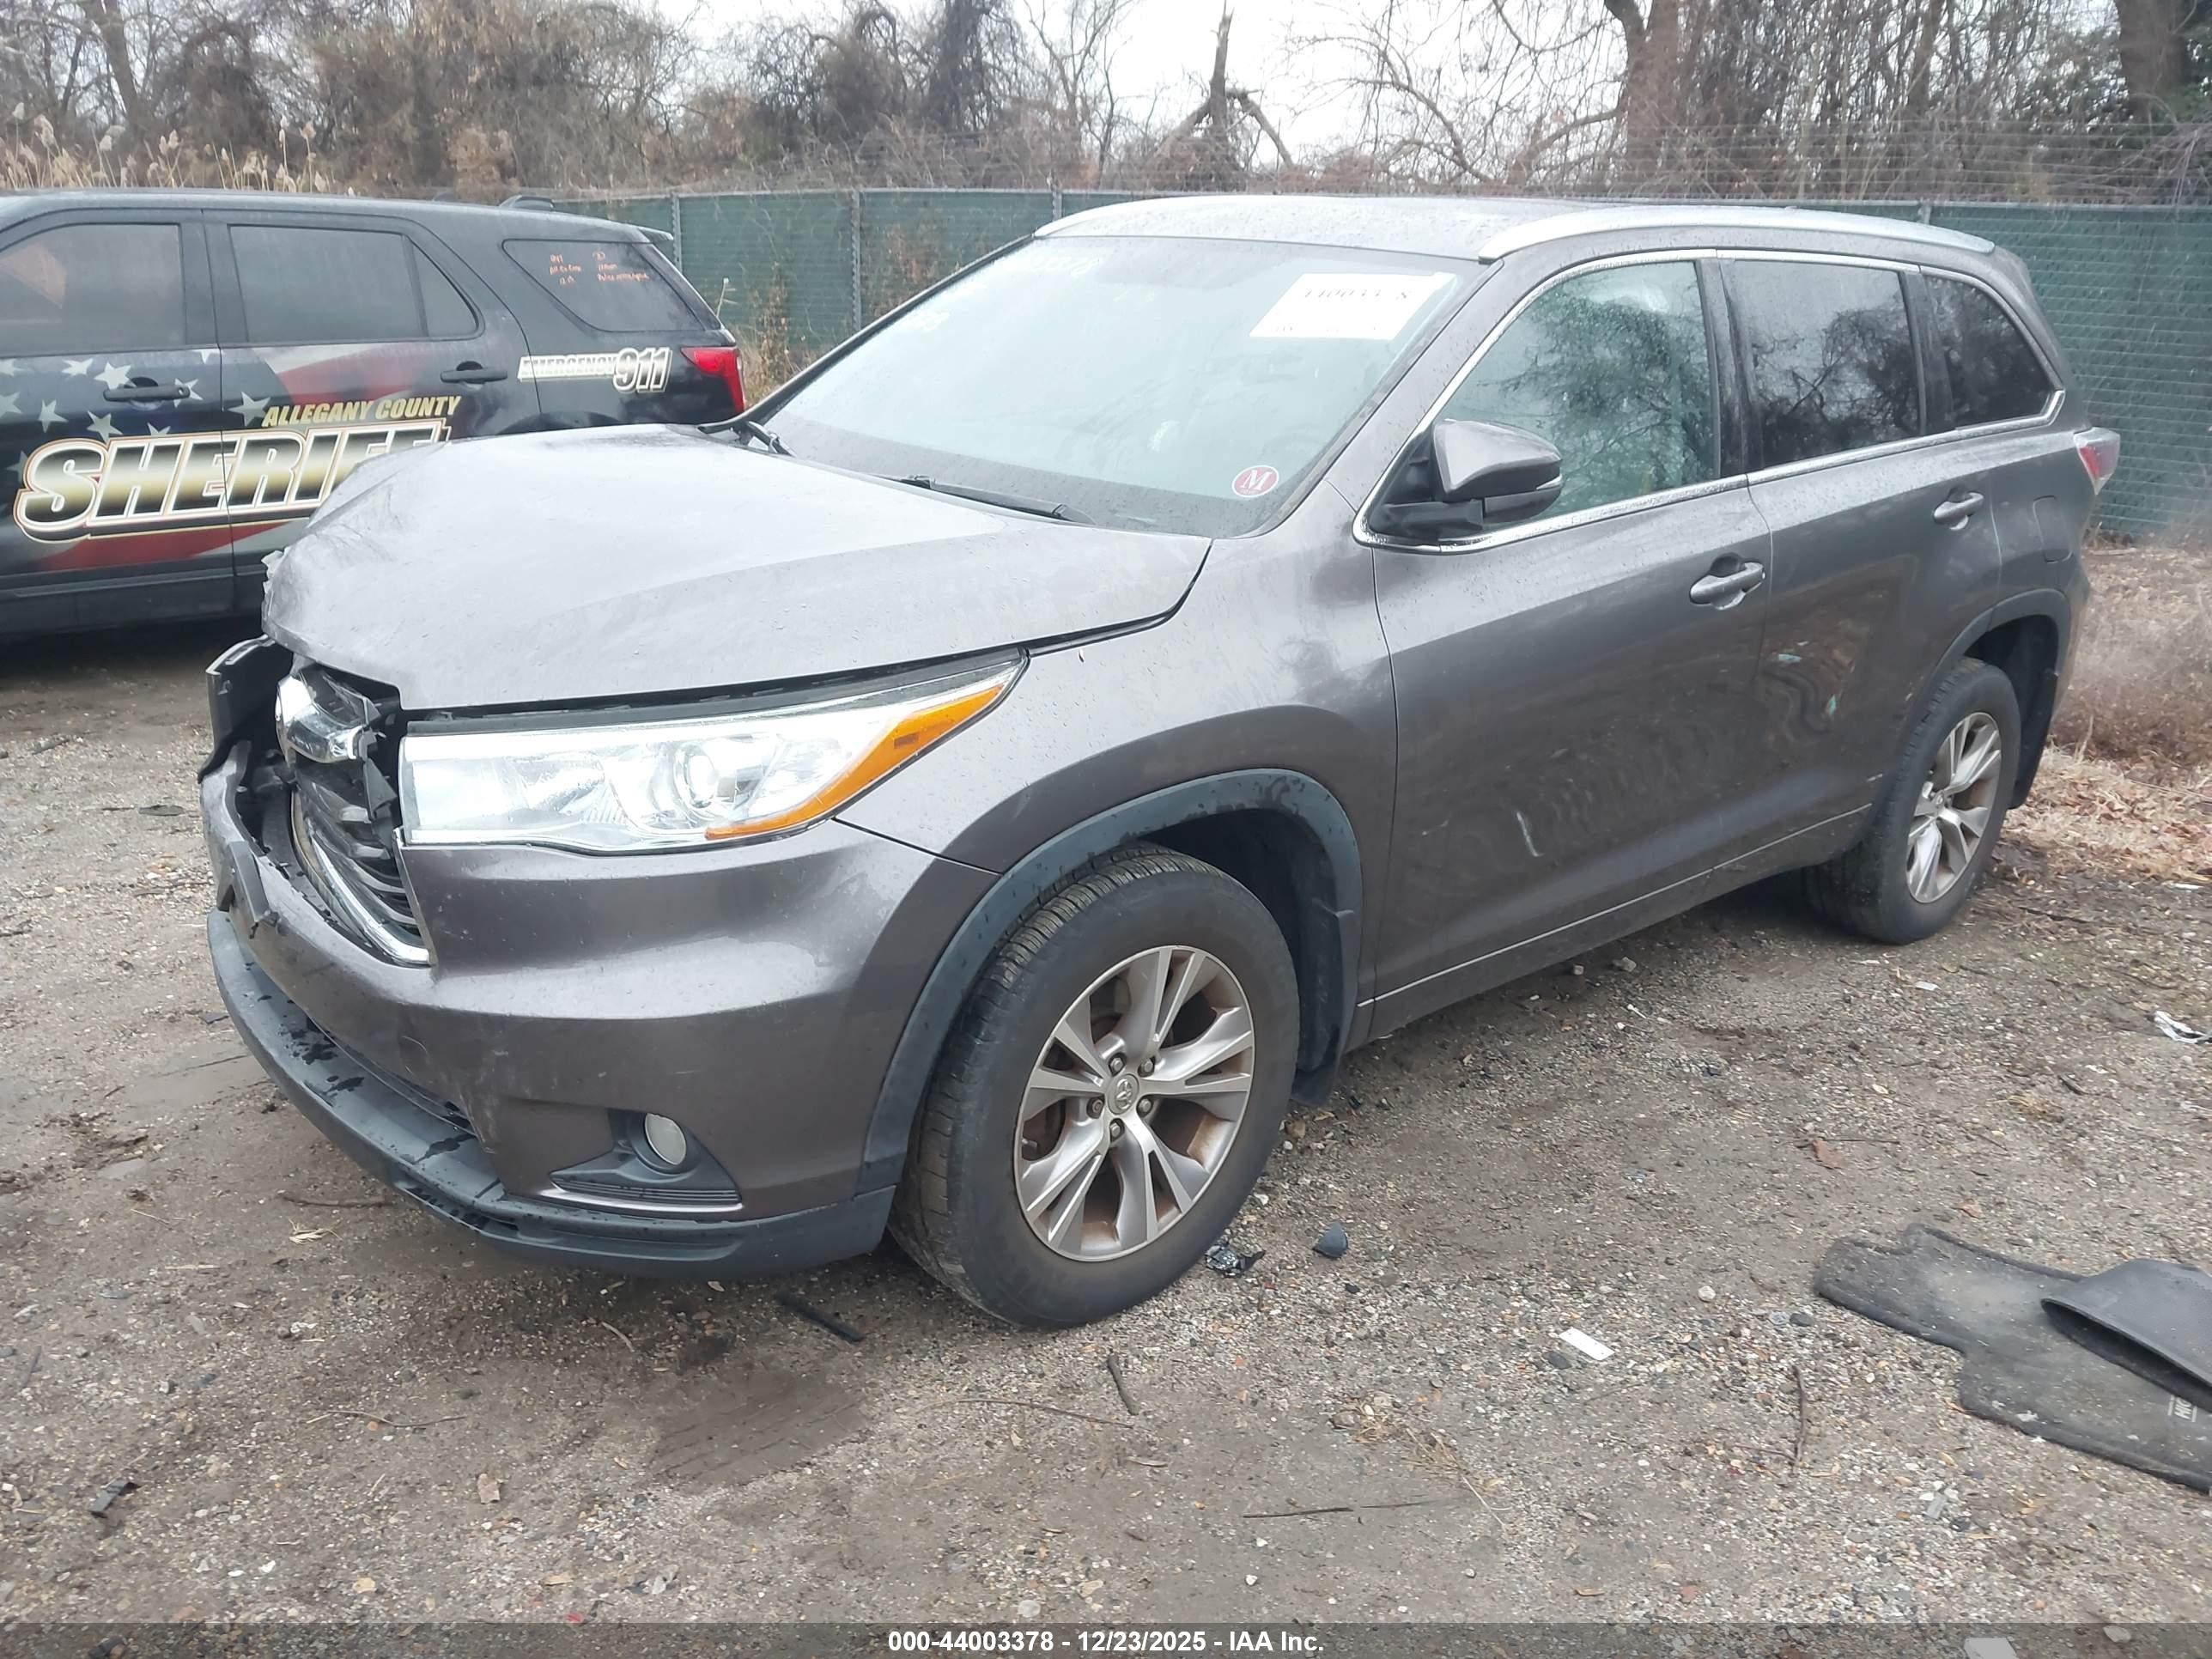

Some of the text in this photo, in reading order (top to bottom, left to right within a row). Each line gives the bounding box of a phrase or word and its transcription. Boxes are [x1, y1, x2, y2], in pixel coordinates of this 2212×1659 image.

[613, 347, 672, 393] 911
[261, 395, 462, 428] ALLEGANY COUNTY
[17, 424, 441, 531] SHERIF
[1239, 469, 1273, 491] M
